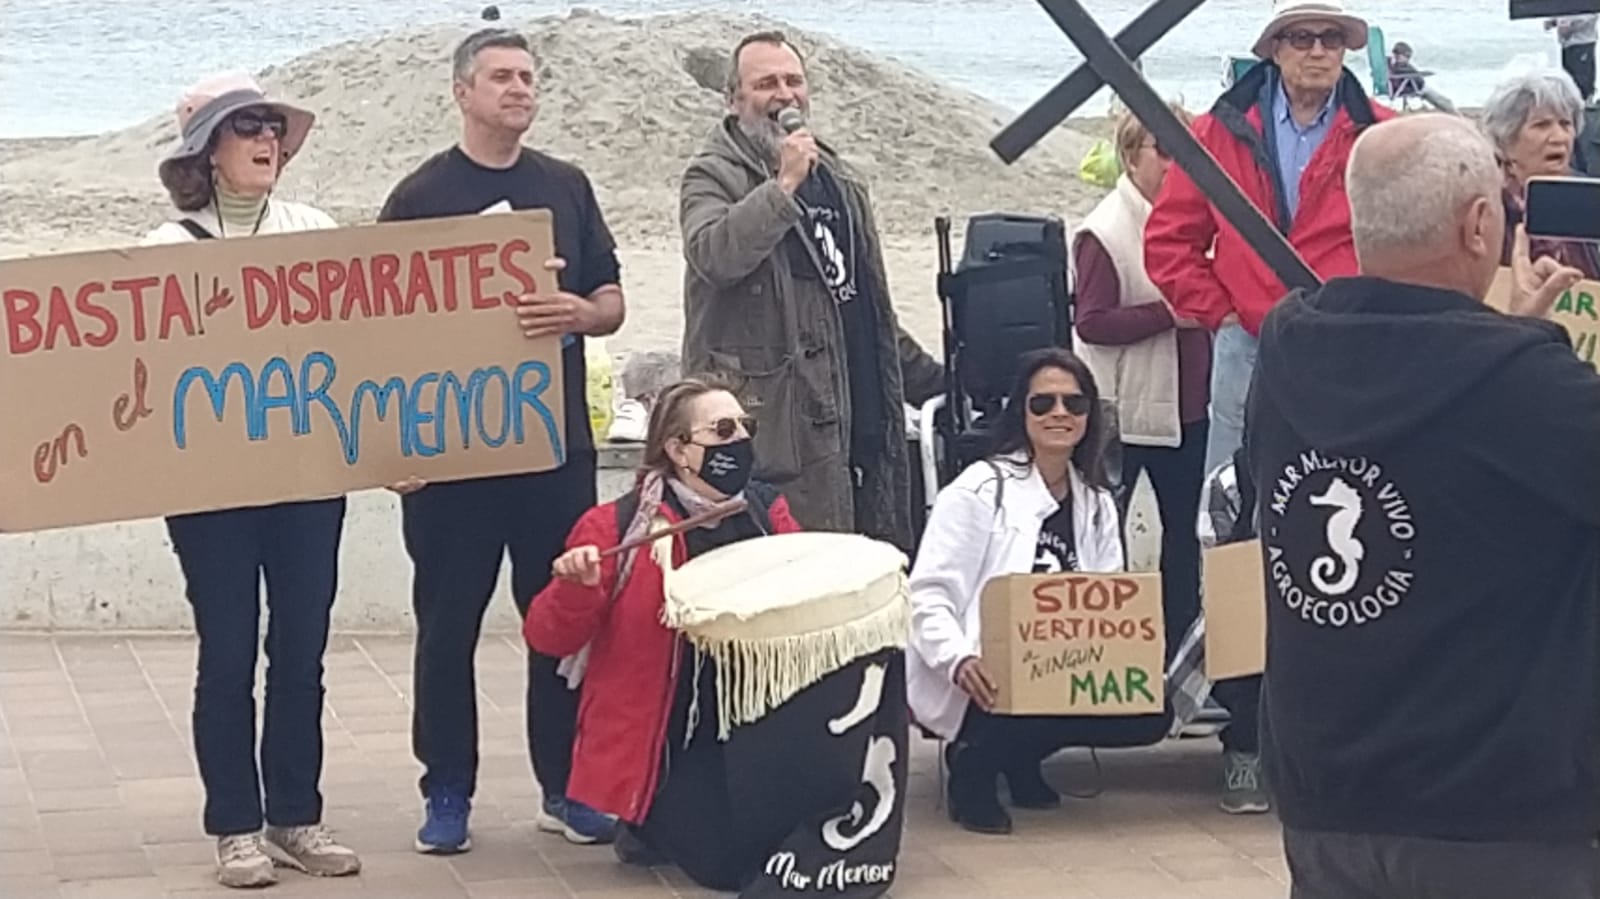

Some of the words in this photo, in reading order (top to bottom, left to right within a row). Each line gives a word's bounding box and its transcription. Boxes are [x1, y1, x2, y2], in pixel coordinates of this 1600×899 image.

[205, 277, 234, 318] de
[242, 240, 532, 330] DISPARATES
[34, 423, 89, 483] en
[113, 358, 153, 431] el
[173, 351, 359, 464] MAR
[351, 361, 564, 465] MENOR
[1271, 466, 1303, 516] MAR
[1377, 483, 1415, 540] VIVO
[1033, 577, 1139, 613] STOP
[1018, 618, 1157, 642] VERTIDOS
[1070, 667, 1155, 705] MAR
[765, 852, 811, 889] Mar
[817, 860, 893, 890] Menor
